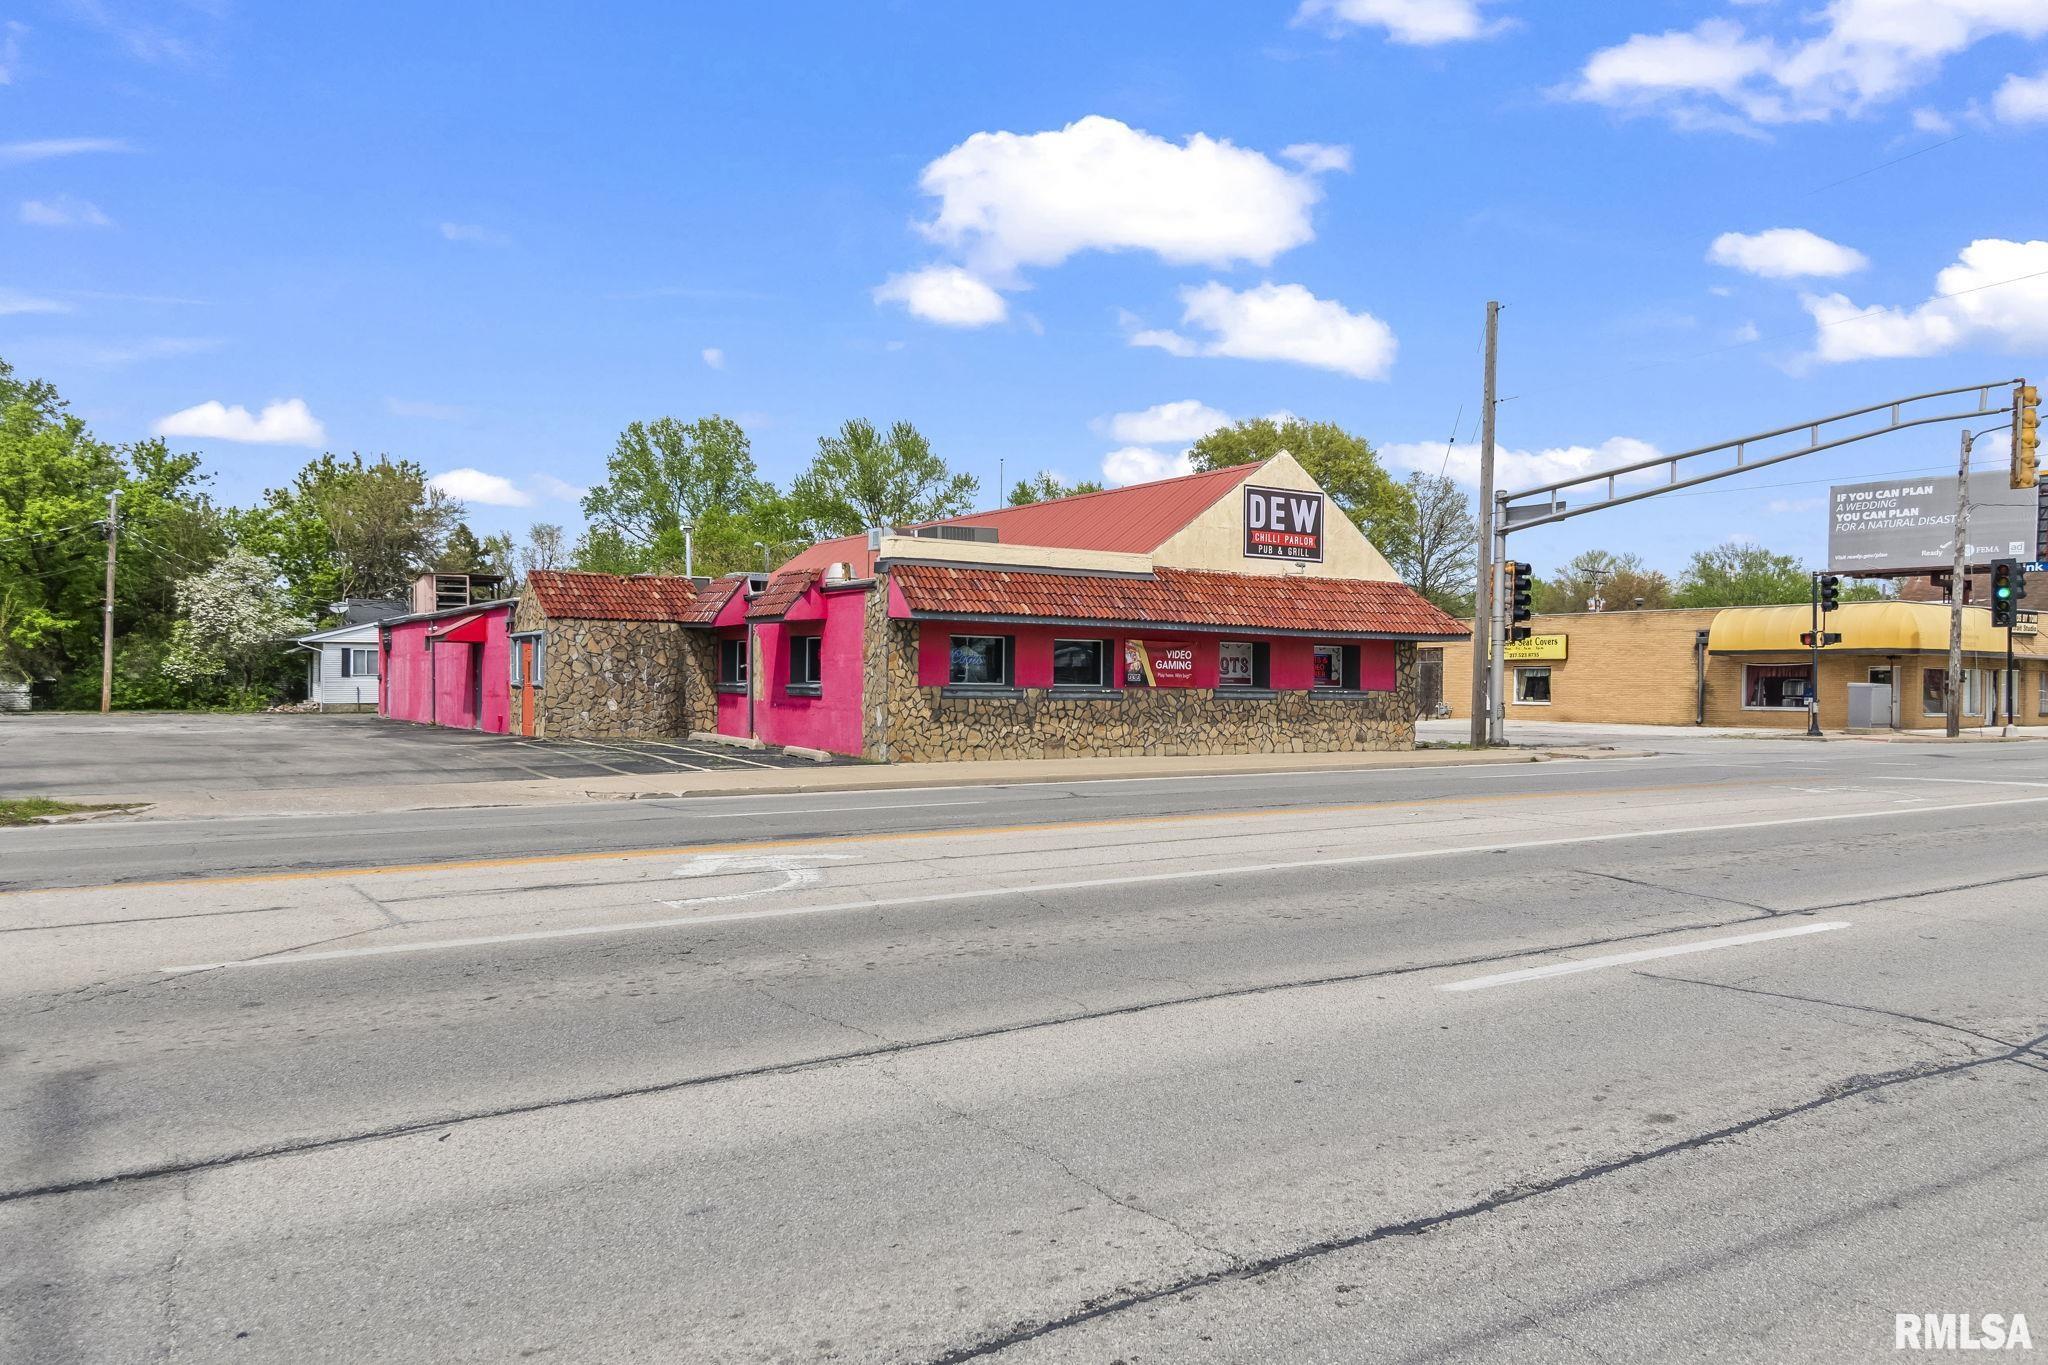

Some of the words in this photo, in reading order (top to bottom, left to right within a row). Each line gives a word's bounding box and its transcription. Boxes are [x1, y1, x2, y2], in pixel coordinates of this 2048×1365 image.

[1836, 493, 1847, 502] IF
[1849, 491, 1873, 501] YOU
[1875, 488, 1900, 499] CAN
[1902, 485, 1934, 497] PLAN
[1836, 503, 1844, 512] A
[1846, 499, 1897, 511] WEDDING
[1250, 494, 1318, 533] DEW
[1836, 512, 1860, 522] YOU
[1862, 510, 1886, 520] CAN
[1889, 507, 1919, 518] PLAN
[1836, 522, 1856, 532] FOR
[1858, 521, 1866, 530] A
[1867, 518, 1916, 530] NATURAL
[1918, 514, 1971, 526] DISAST?
[1254, 533, 1280, 543] CHILLI
[1284, 535, 1314, 546] PARLOR
[1258, 545, 1273, 554] PUB
[1277, 546, 1283, 555] &
[1288, 547, 1310, 557] GRILL
[1921, 549, 1943, 557] Ready
[1976, 545, 2000, 554] FEMA
[1518, 638, 1532, 646] Seat
[1535, 637, 1558, 646] Covers
[1166, 650, 1192, 660] VIDEO
[1155, 660, 1192, 670] GAMING
